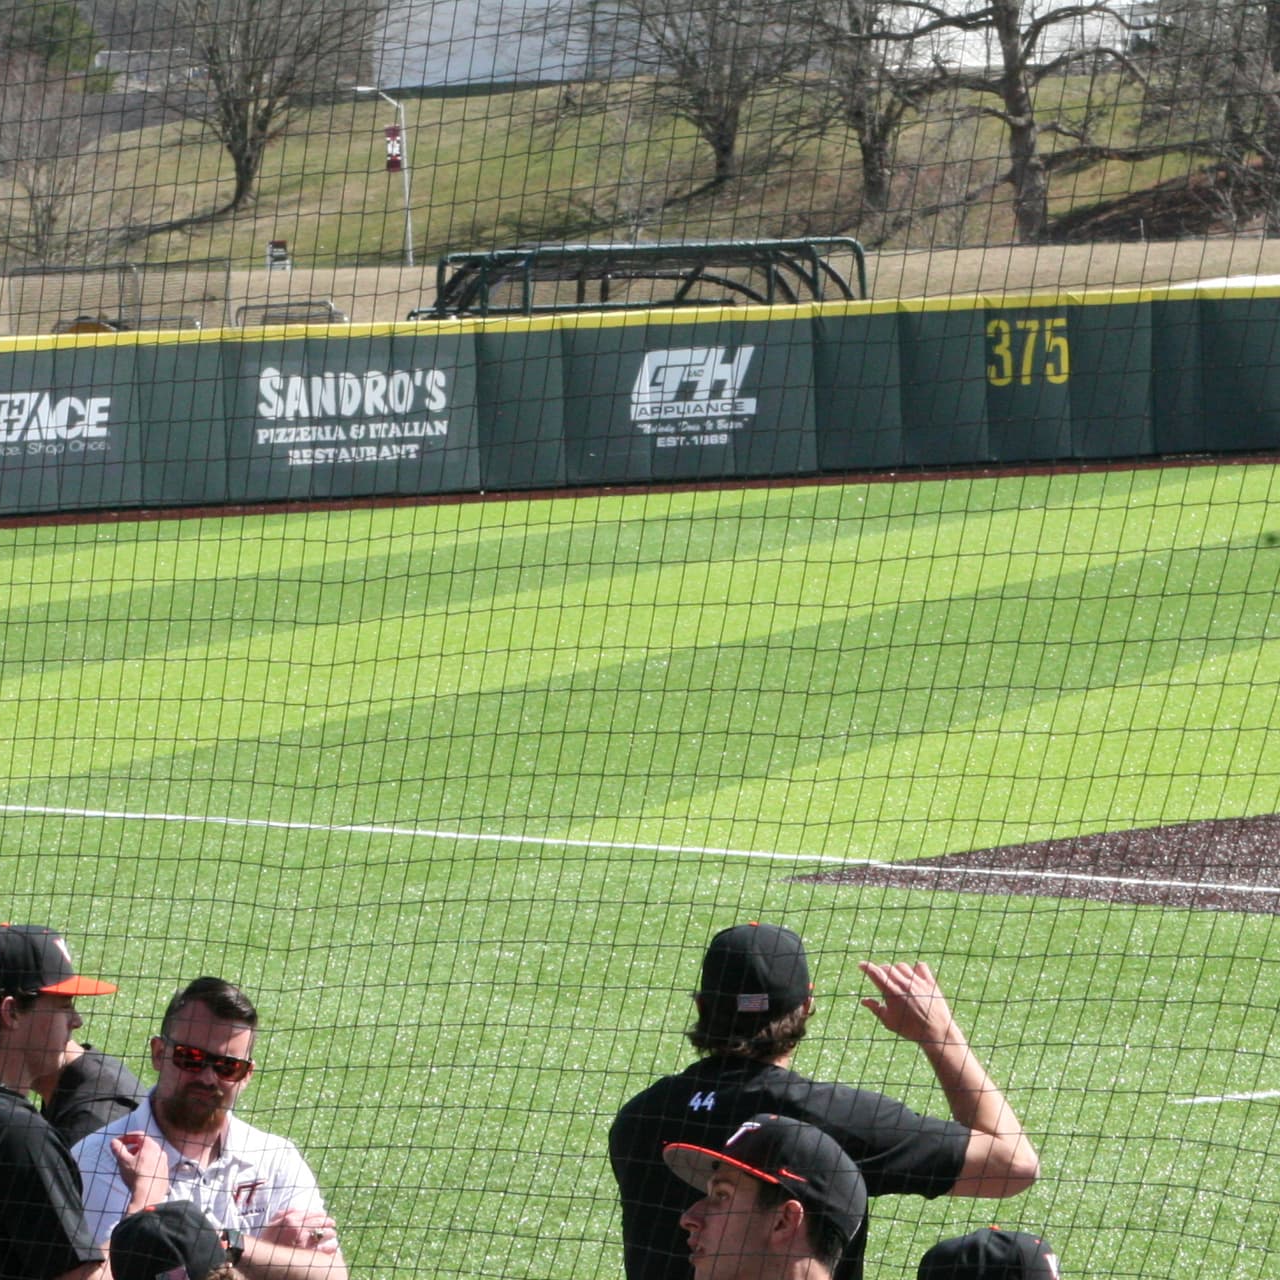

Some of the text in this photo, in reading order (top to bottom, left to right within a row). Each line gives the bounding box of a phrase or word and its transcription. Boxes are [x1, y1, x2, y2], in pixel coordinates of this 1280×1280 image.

[985, 317, 1070, 387] 375
[257, 366, 447, 421] SANDRO'S
[23, 392, 111, 442] ACE
[637, 401, 746, 417] APPLIANCE
[256, 420, 449, 445] PIZZERIA & ITALIAN
[27, 442, 65, 456] Shop
[288, 443, 419, 466] RESTAURANT
[688, 1090, 717, 1112] 44
